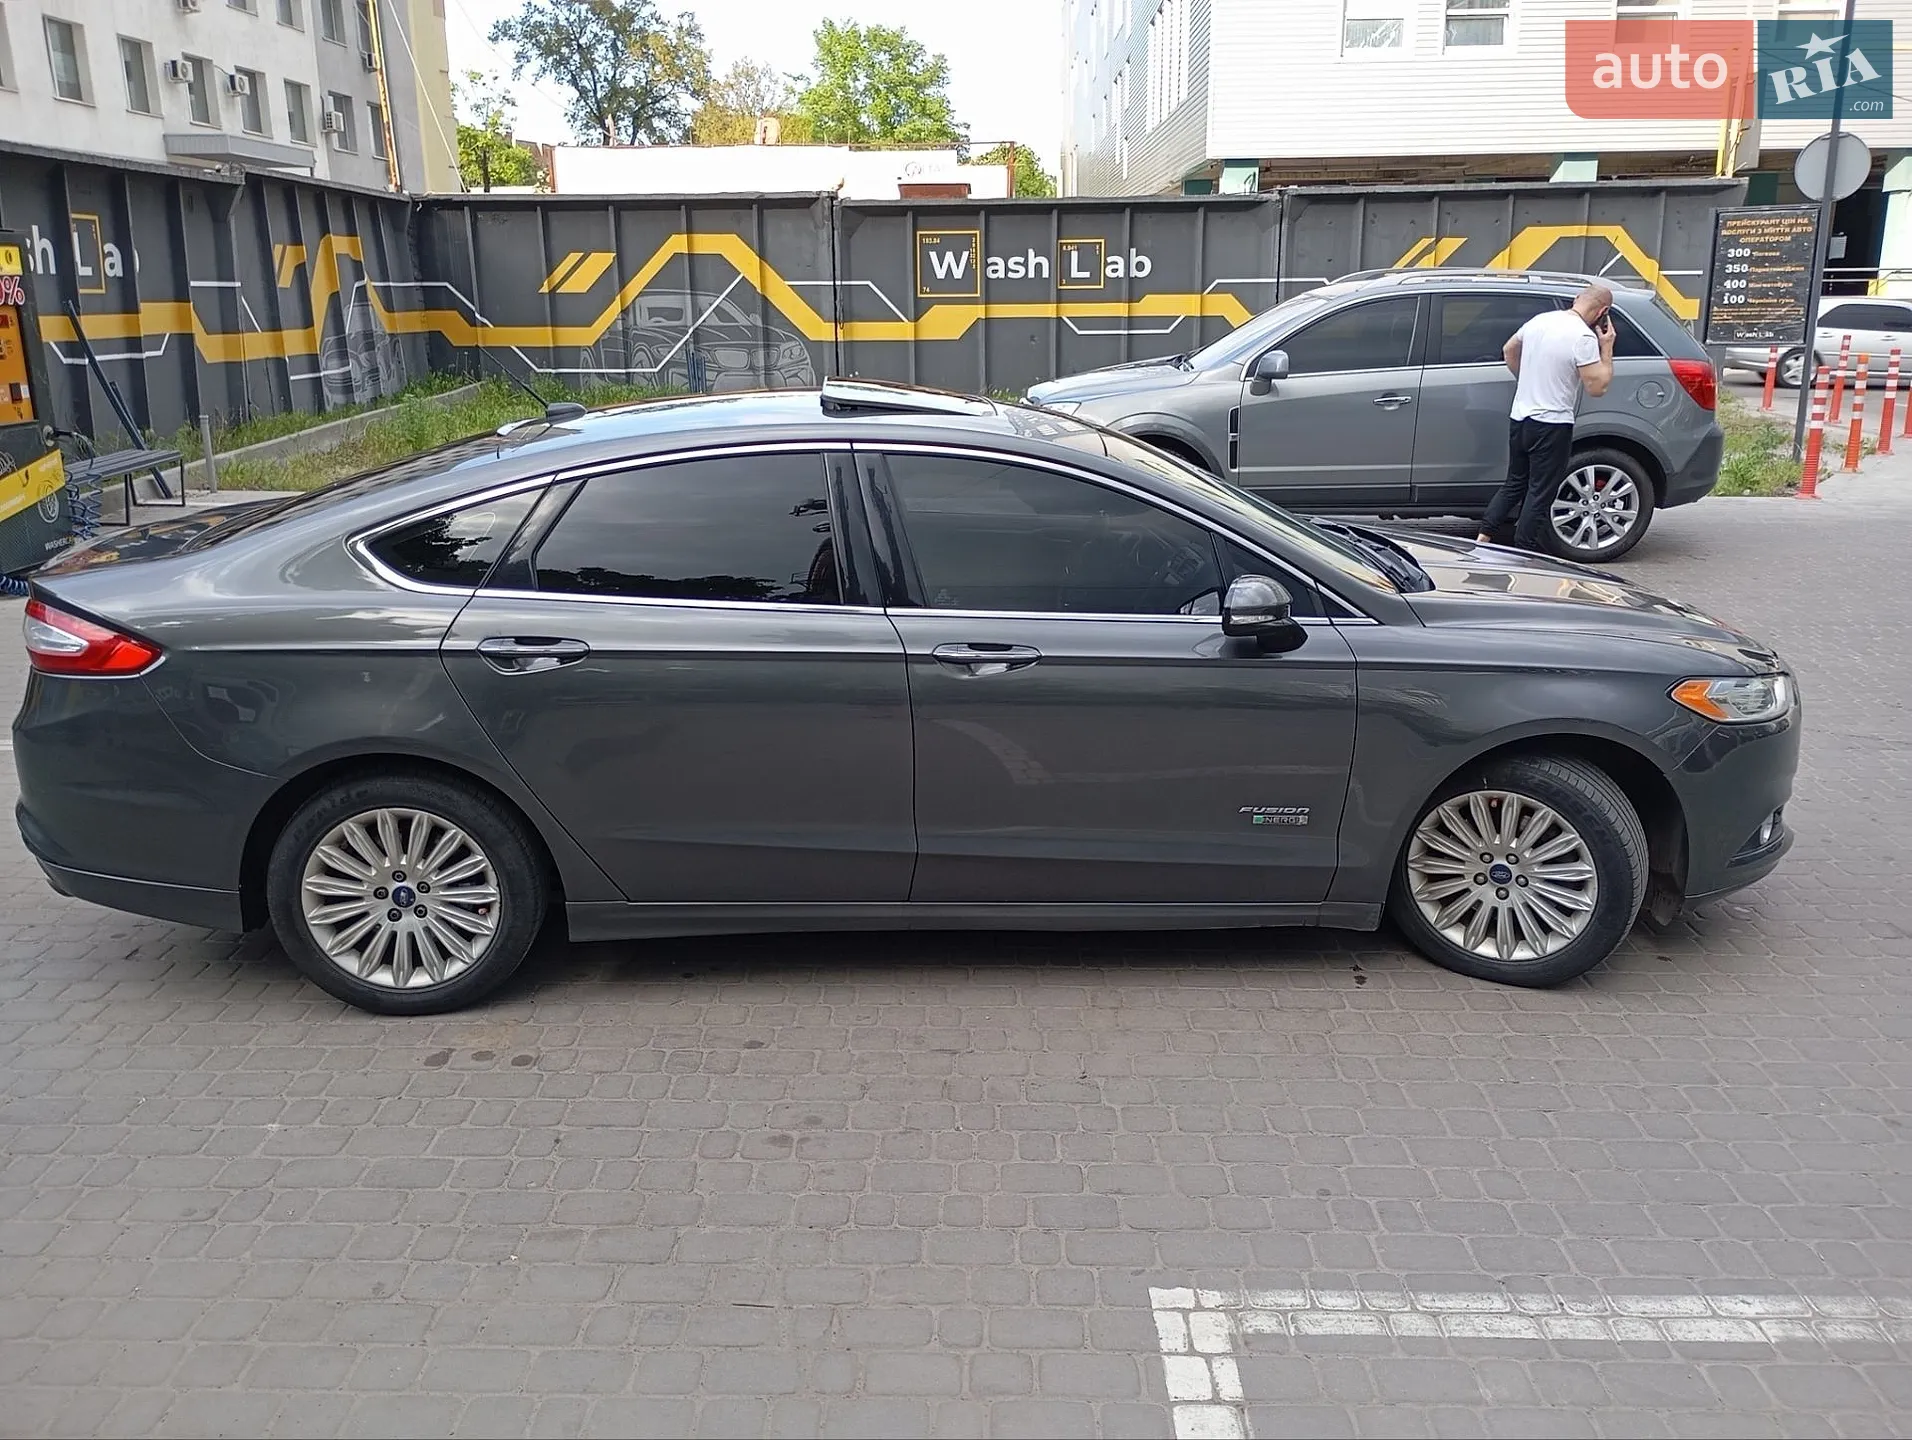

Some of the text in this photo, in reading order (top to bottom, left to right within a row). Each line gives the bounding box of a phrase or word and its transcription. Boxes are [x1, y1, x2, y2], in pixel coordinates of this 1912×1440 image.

[1726, 219, 1780, 227] ПРЕЙСКУРАНТ
[72, 230, 140, 278] La
[1727, 248, 1751, 257] 300
[1070, 248, 1152, 279] Lab
[1725, 264, 1749, 273] 350
[1723, 279, 1747, 288] 400
[1722, 294, 1745, 304] 100
[1239, 806, 1310, 814] FUSION
